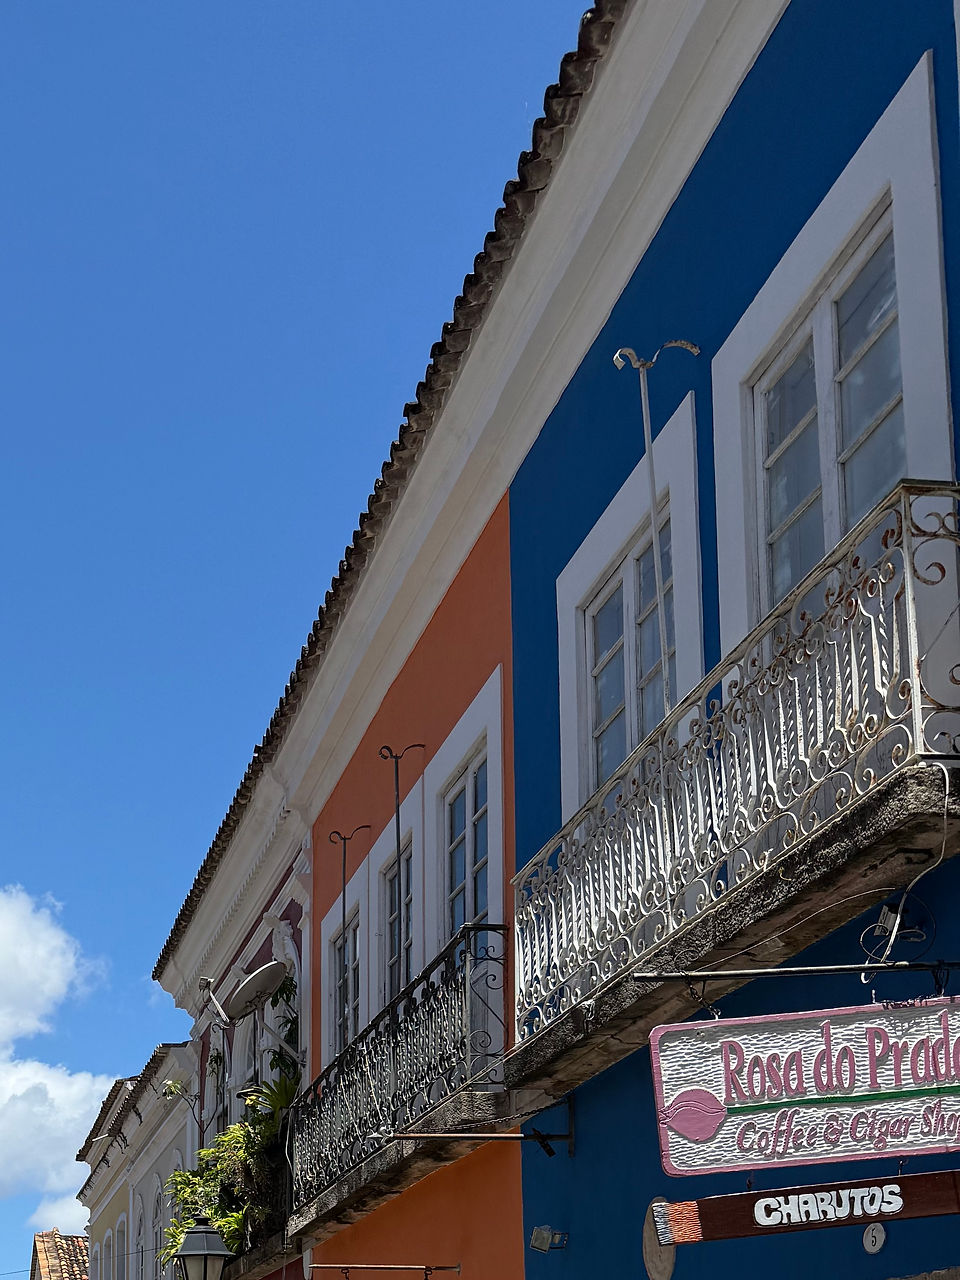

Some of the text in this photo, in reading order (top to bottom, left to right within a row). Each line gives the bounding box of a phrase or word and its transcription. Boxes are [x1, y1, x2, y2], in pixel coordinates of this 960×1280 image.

[720, 1040, 807, 1104] Rosa
[813, 1019, 856, 1095] do
[736, 1107, 818, 1160] Coffee
[823, 1113, 842, 1145] &
[849, 1110, 912, 1151] Cigar
[754, 1184, 904, 1226] CHARUTOS
[870, 1227, 877, 1247] 5
